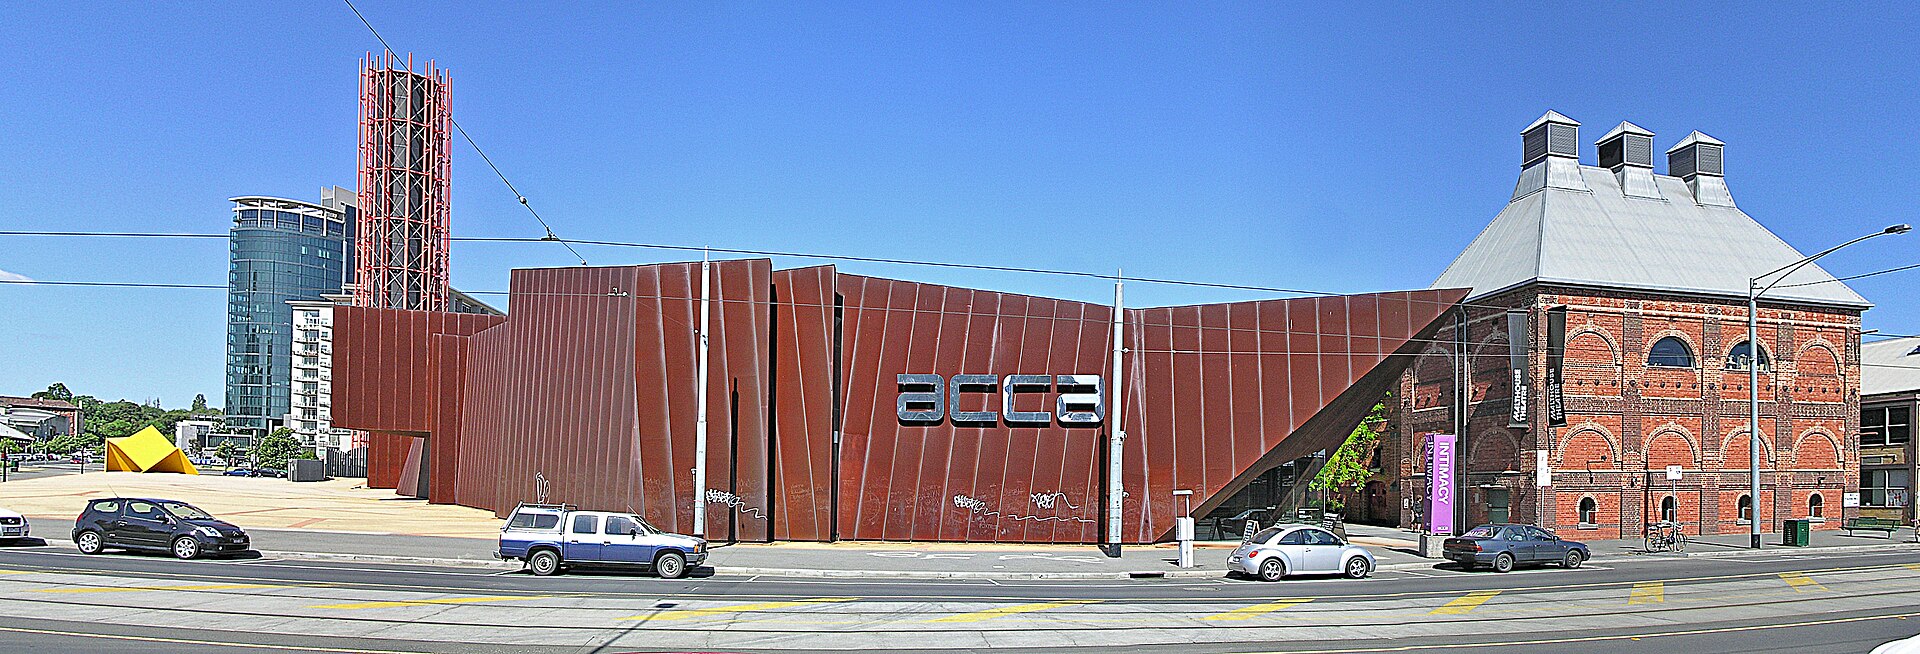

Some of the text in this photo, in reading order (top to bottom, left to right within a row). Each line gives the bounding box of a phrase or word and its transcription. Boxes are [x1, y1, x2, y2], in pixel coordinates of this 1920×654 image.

[897, 373, 1105, 423] acca
[1513, 368, 1522, 421] MALTHOUSE
[1520, 385, 1528, 421] THEATRE
[1554, 383, 1562, 420] THEATRE
[1438, 441, 1450, 505] INTIMACY
